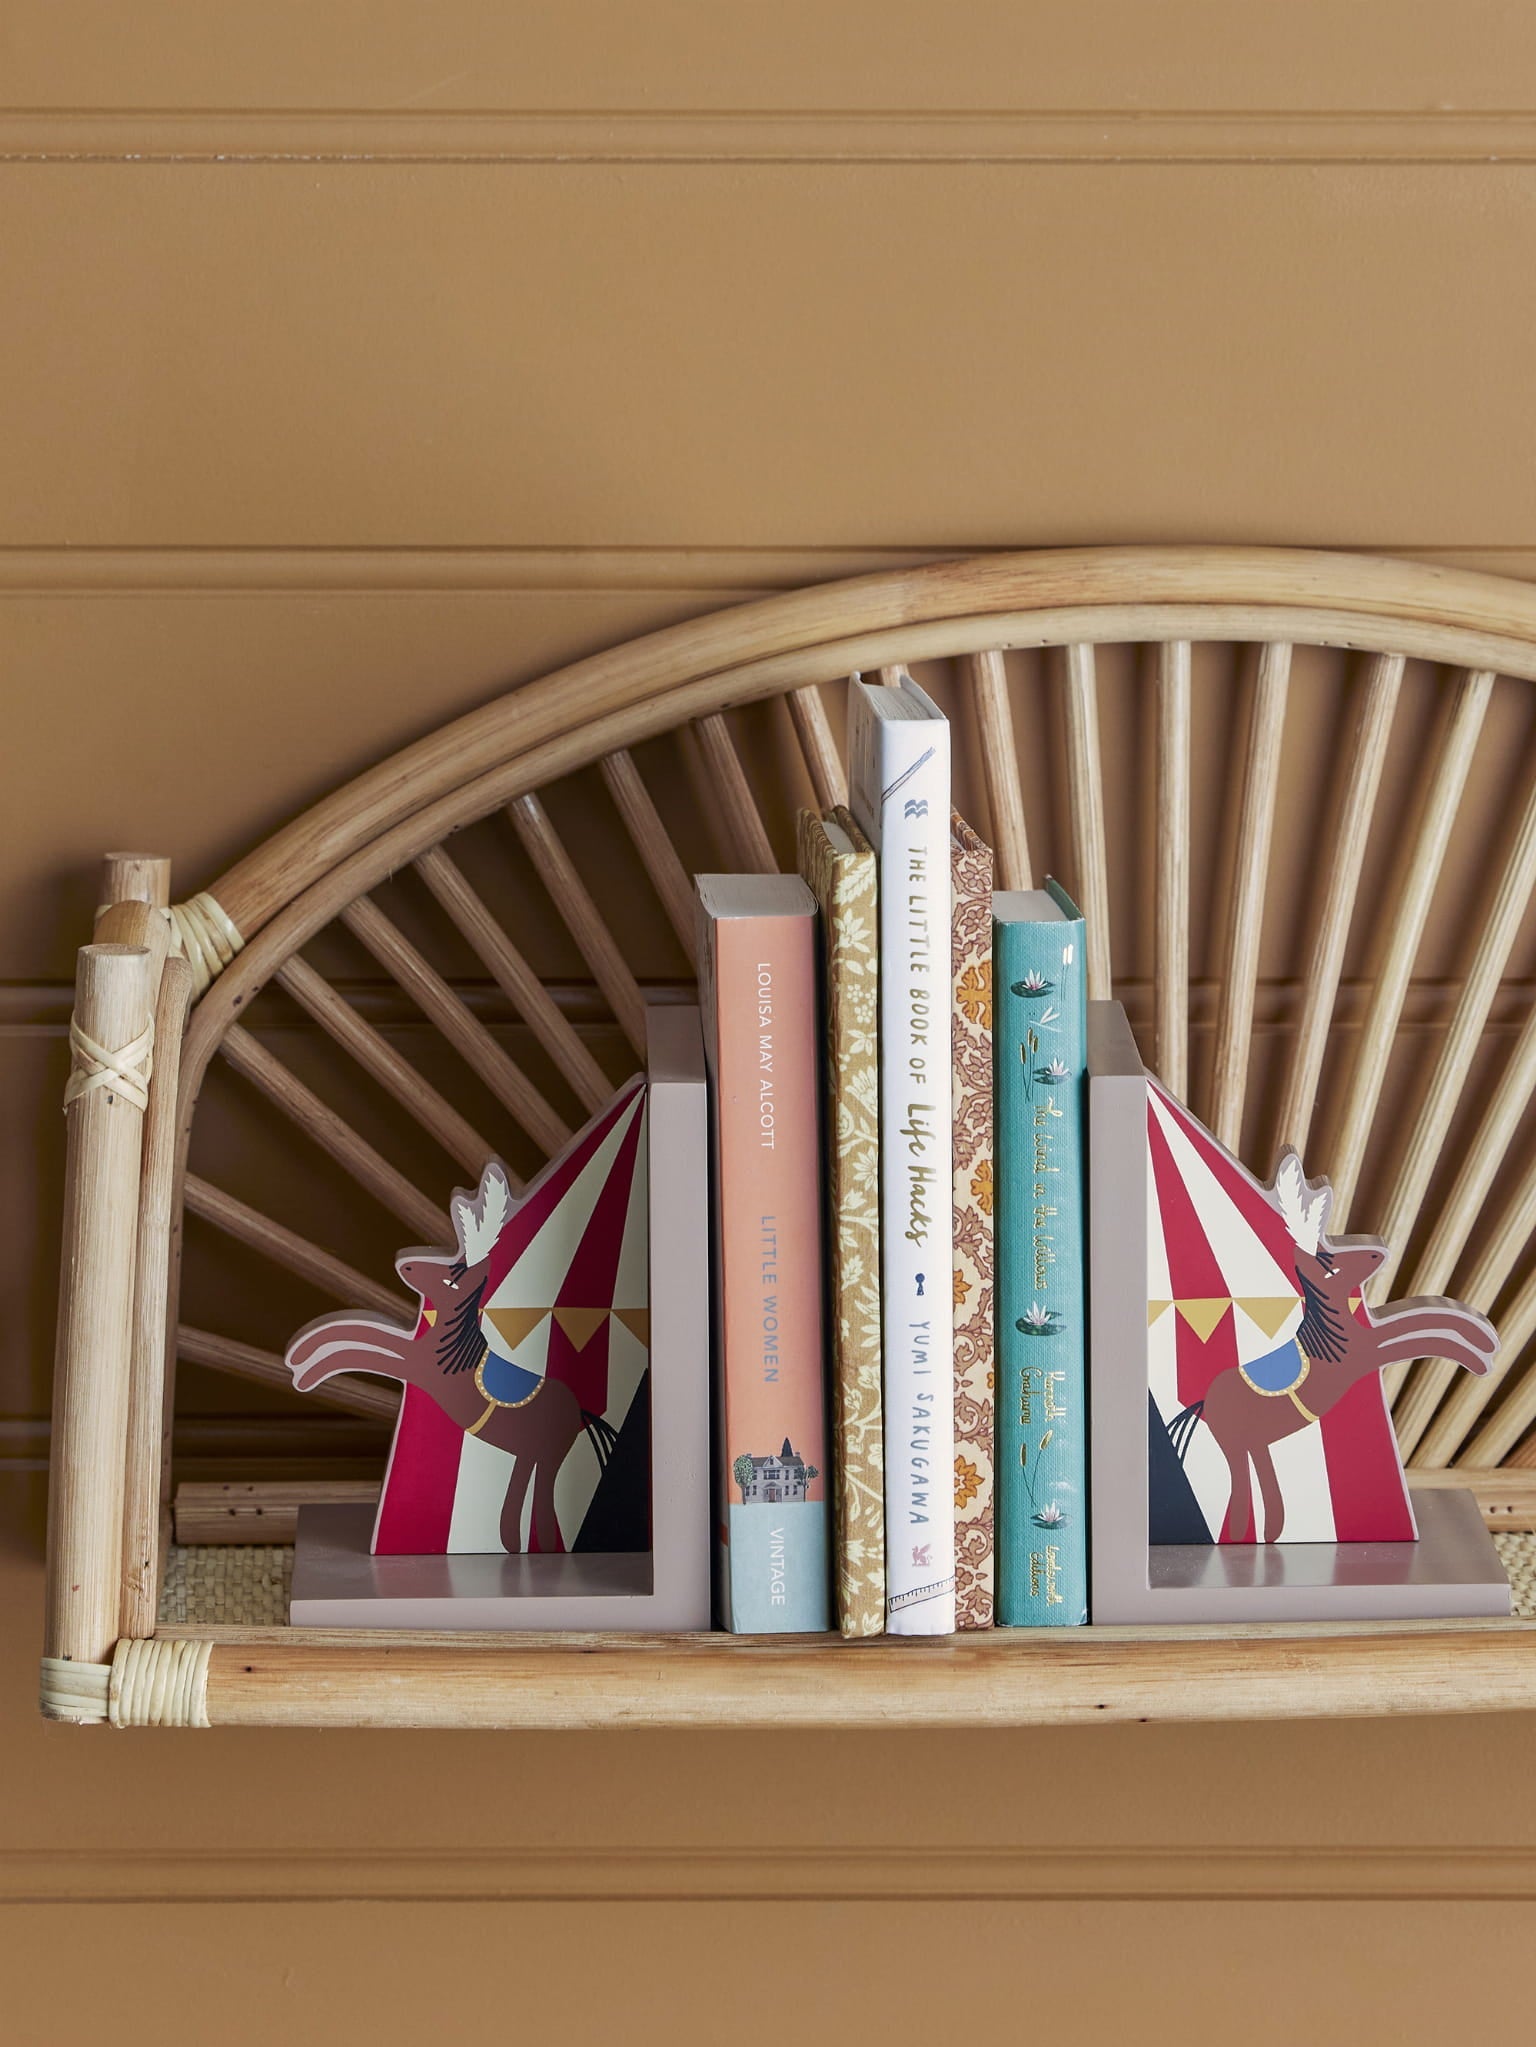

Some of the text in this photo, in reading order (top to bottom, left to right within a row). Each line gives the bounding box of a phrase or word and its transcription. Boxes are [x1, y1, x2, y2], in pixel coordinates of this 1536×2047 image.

[757, 962, 775, 1149] LOUISA MAY ALCOTT
[899, 846, 938, 1249] THE LITTLE BOOK OF Life Hacks
[1033, 1096, 1064, 1127] The
[1033, 1133, 1061, 1174] Wind
[1033, 1204, 1058, 1229] the
[1032, 1234, 1057, 1291] Willows
[761, 1216, 779, 1383] LITTLE WOMEN
[908, 1320, 934, 1525] YUMI SAKUGAWA
[1019, 1366, 1043, 1425] Grahame
[1044, 1370, 1066, 1422] Kenneth
[769, 1527, 786, 1606] VINTAGE
